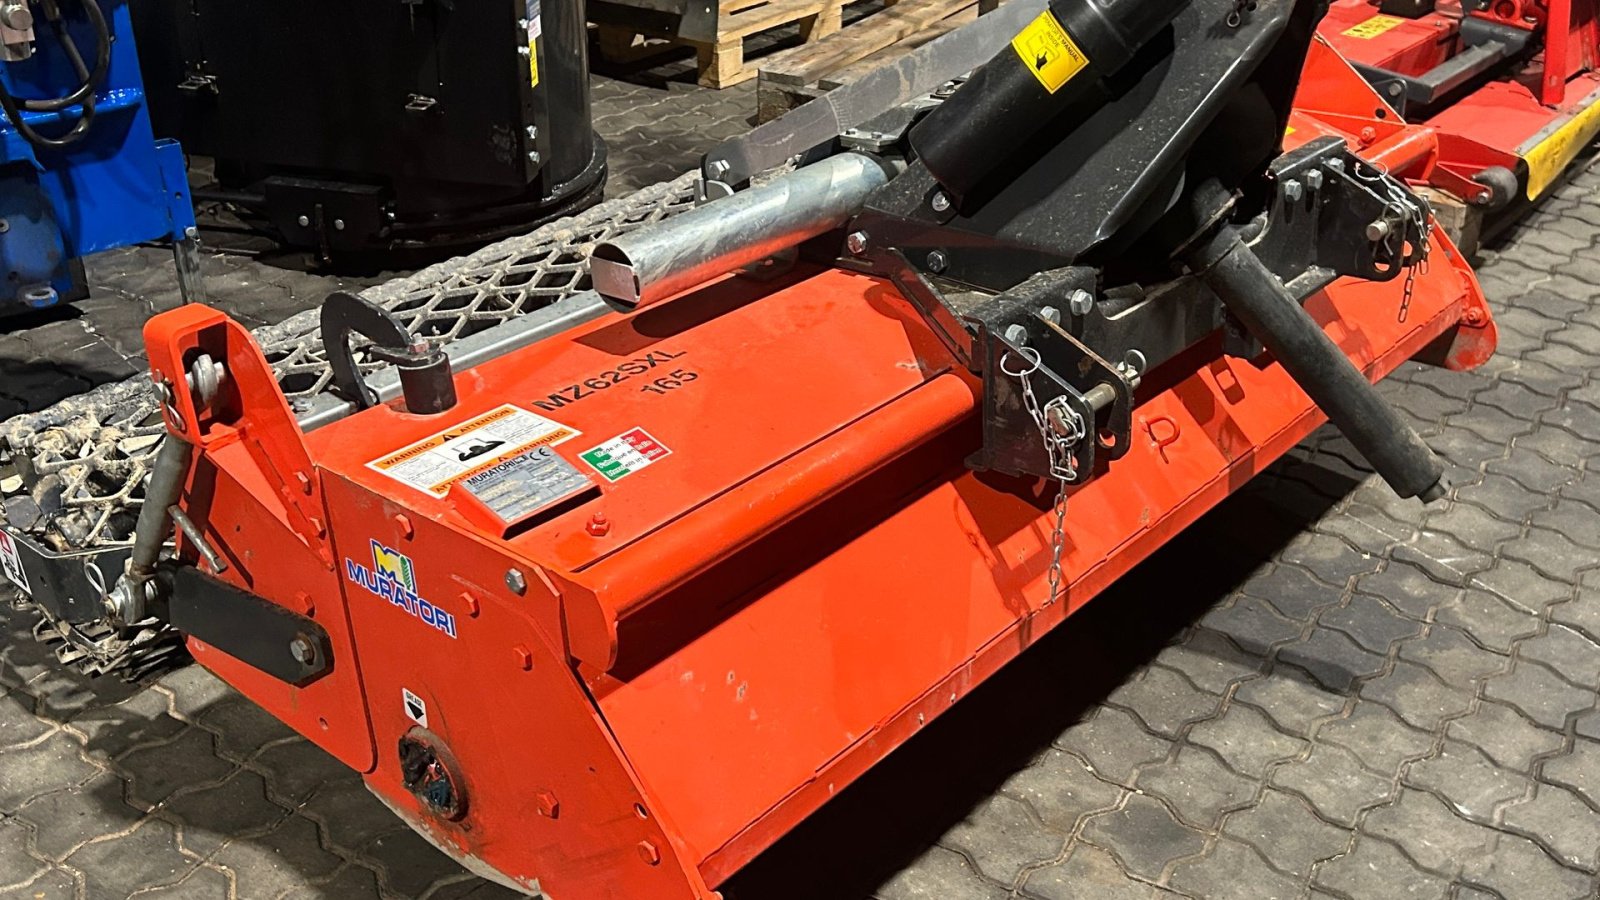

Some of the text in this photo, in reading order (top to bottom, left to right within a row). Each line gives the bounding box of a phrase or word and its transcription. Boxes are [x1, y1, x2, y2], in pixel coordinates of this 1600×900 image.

[532, 350, 688, 411] MZ62SXL
[640, 369, 699, 394] 165
[382, 441, 436, 466] WARNING
[459, 409, 511, 433] ATTENTION
[346, 558, 457, 639] MURATORI
